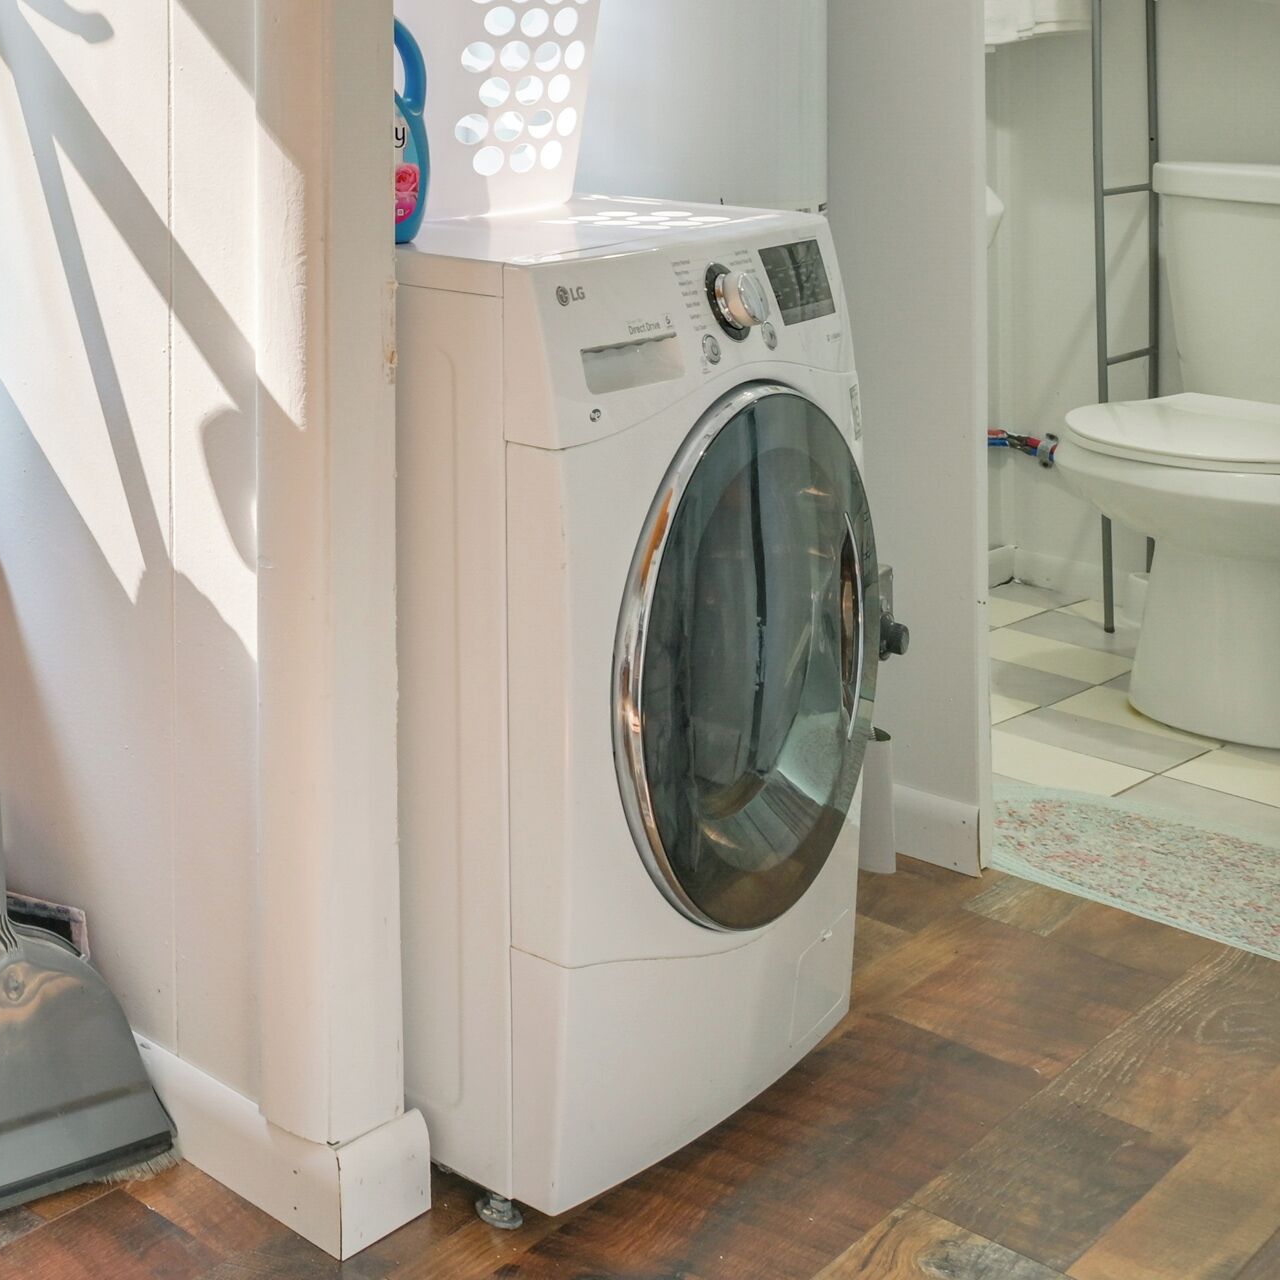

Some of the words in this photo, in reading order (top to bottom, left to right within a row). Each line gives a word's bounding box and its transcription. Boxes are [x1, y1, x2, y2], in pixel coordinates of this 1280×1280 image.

[569, 286, 586, 301] LG
[628, 324, 645, 336] Direct
[645, 321, 661, 332] Drive
